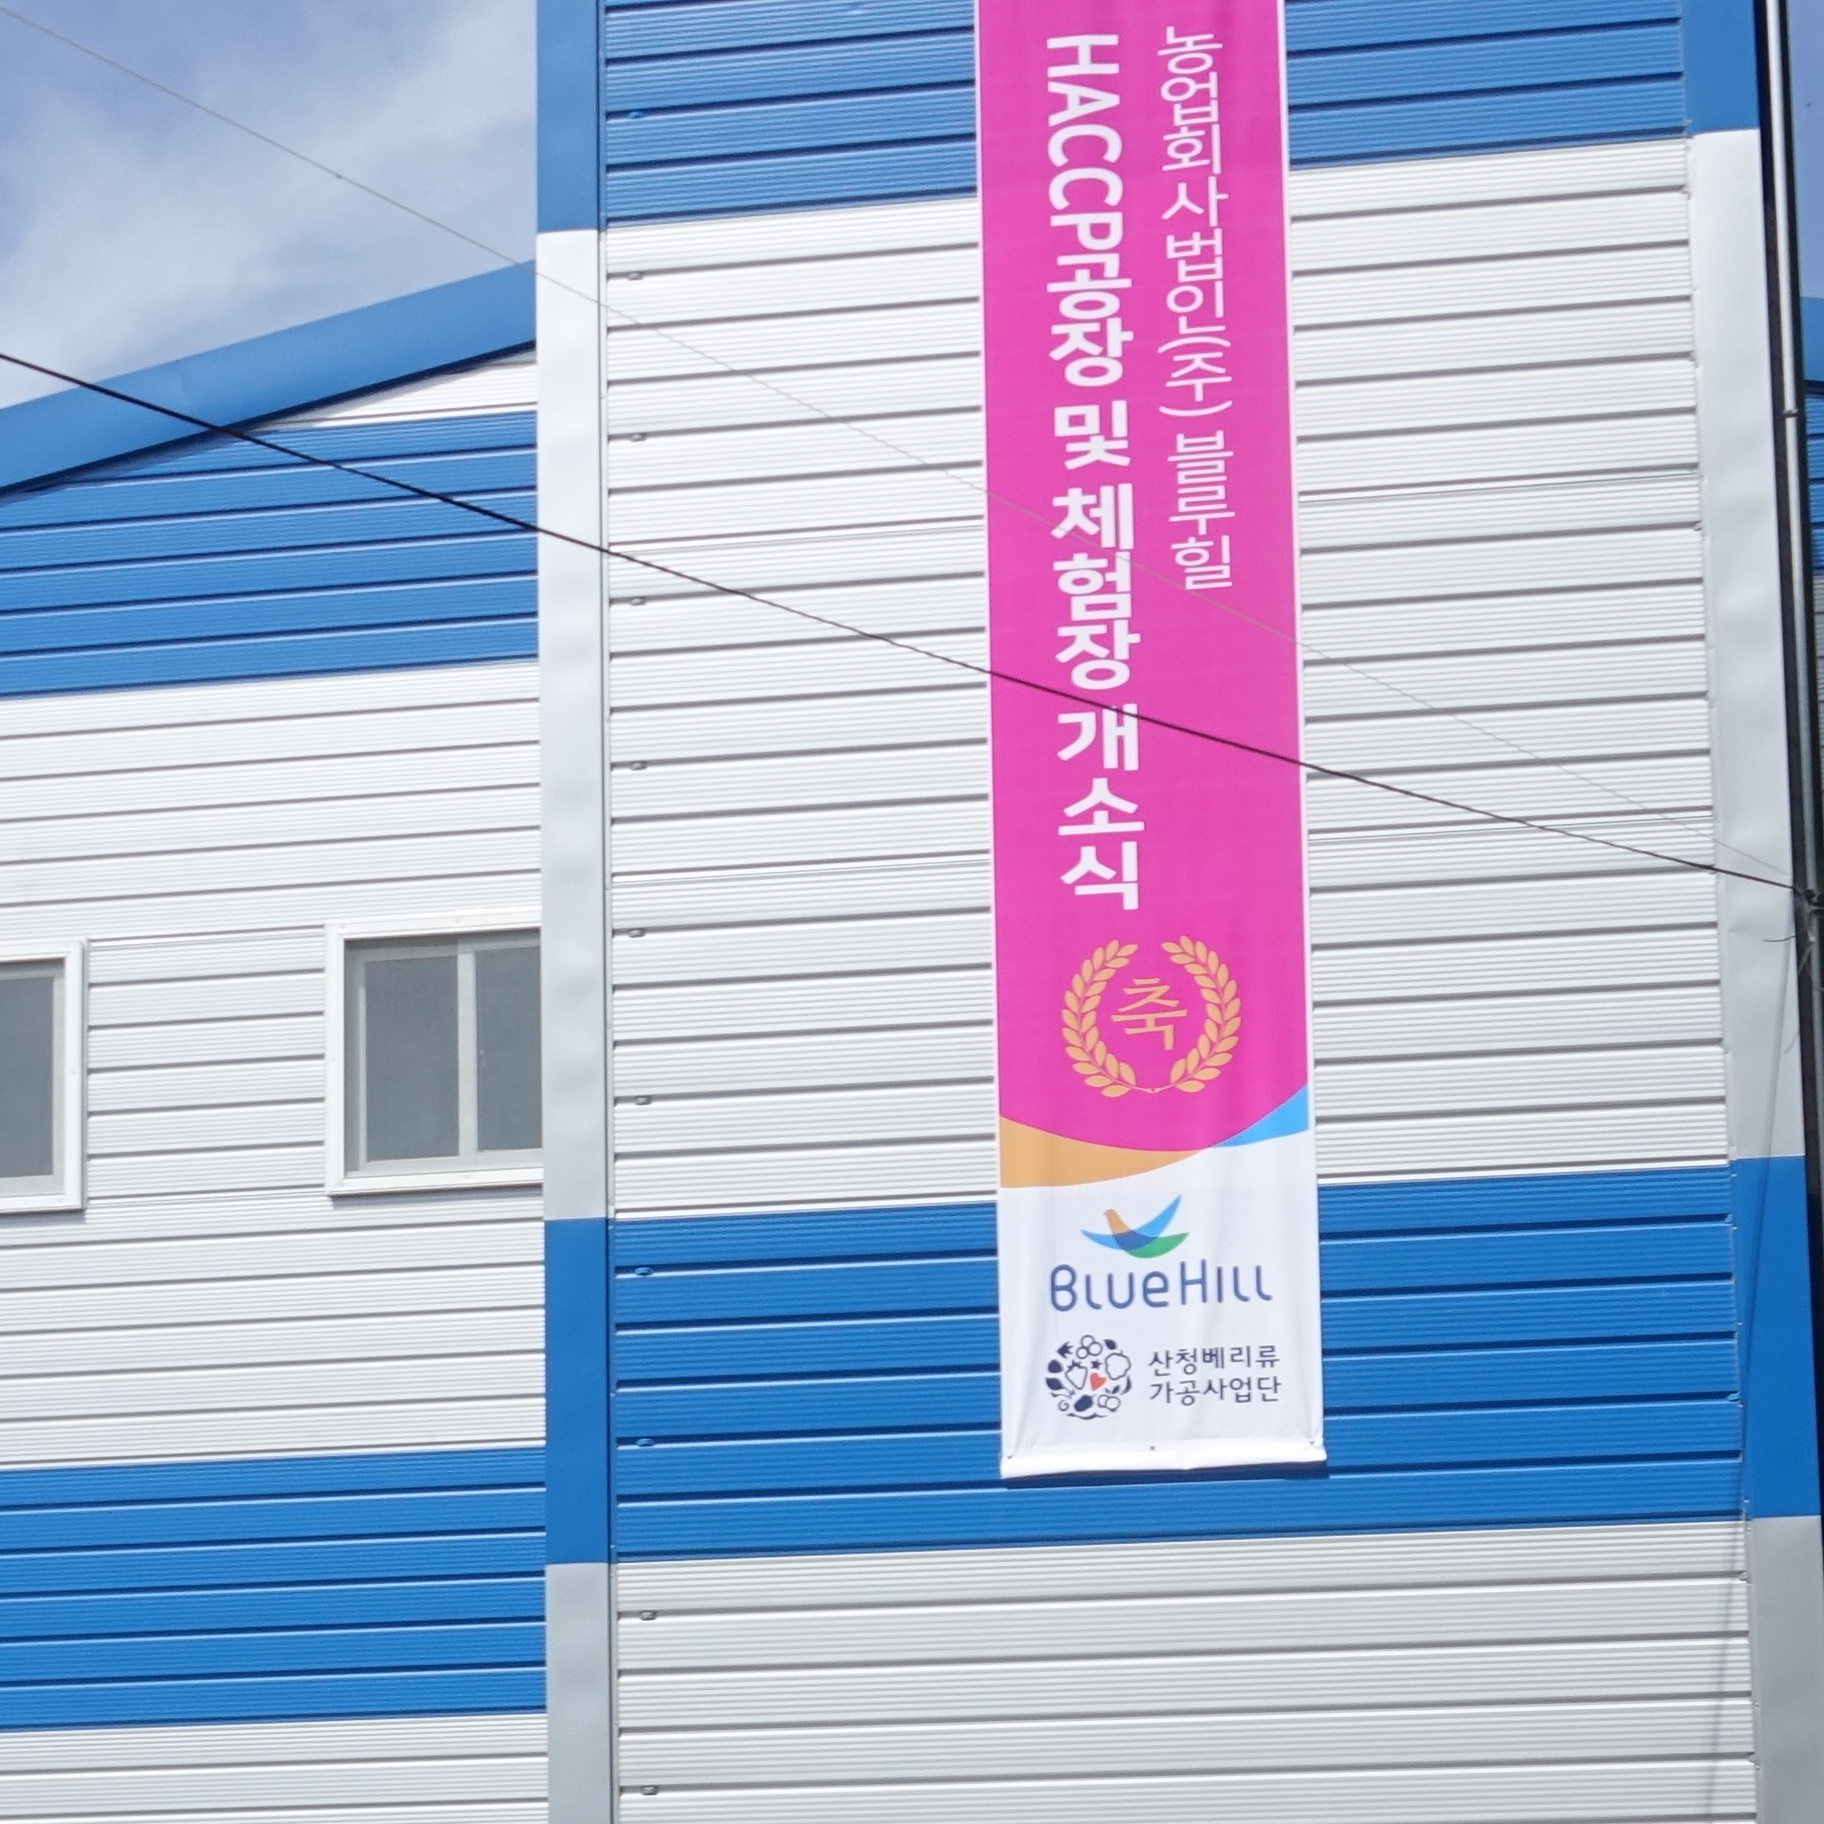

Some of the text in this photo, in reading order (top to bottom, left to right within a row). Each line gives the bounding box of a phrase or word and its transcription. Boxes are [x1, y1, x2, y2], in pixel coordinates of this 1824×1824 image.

[1157, 26, 1236, 591] 농업회사법인(주) 블루힐
[1046, 34, 1145, 910] HACCP공장 및 체험장 개소식
[1111, 977, 1188, 1051] 축
[1147, 1345, 1281, 1377] 산청베리류
[1149, 1376, 1282, 1407] 가공사업단
